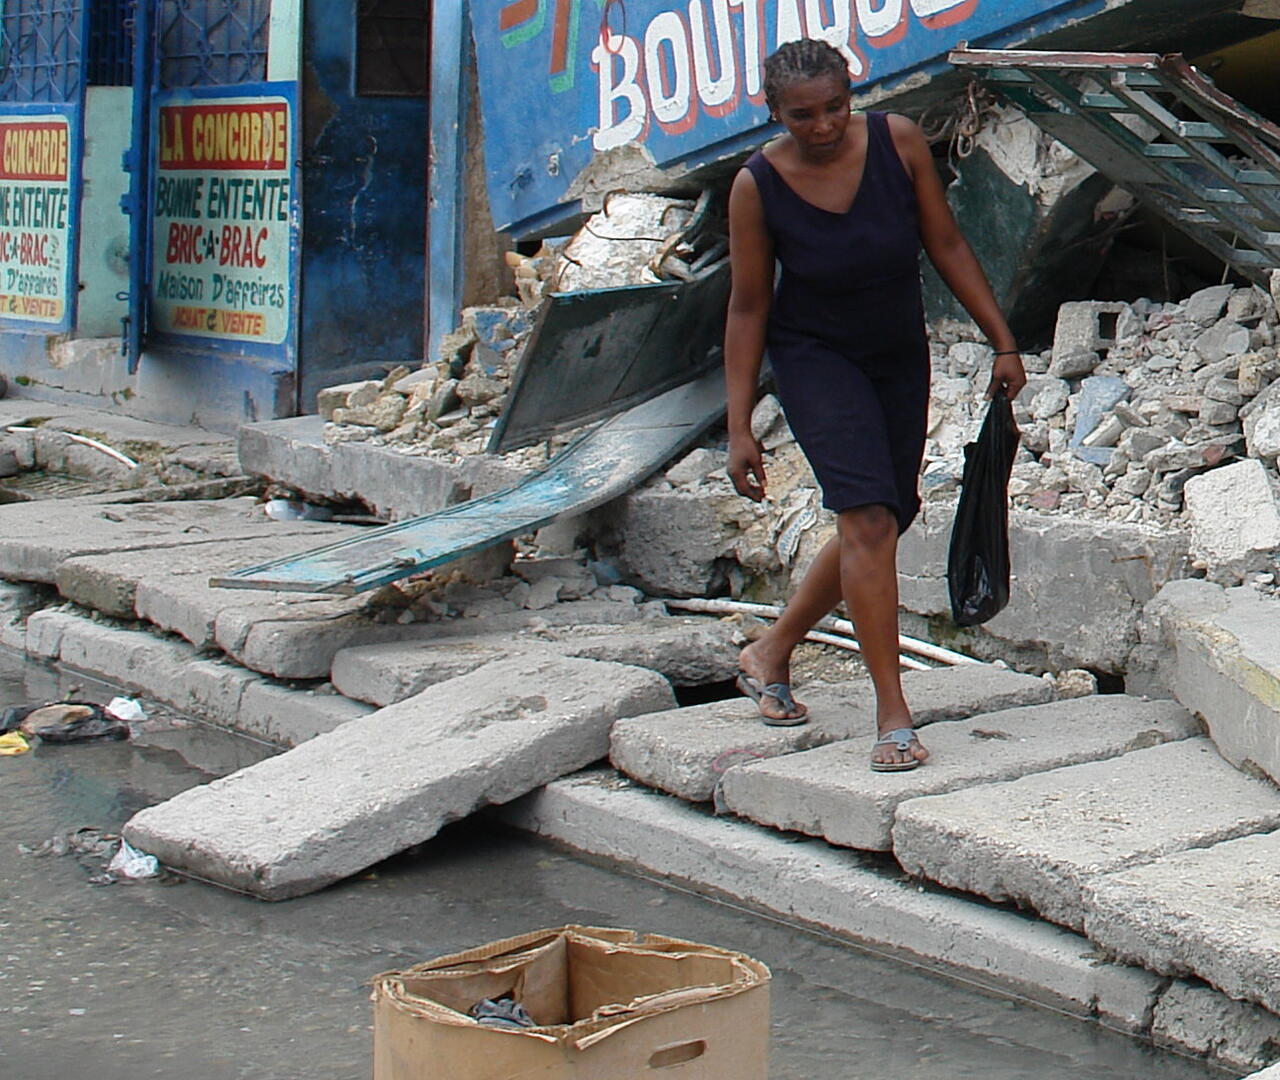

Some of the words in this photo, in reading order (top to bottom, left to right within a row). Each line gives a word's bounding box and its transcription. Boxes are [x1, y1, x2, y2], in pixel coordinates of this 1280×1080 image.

[3, 128, 68, 176] CONCORDE
[161, 112, 184, 162] LA
[192, 110, 286, 162] CONCORDE
[13, 187, 69, 230] ENTENTE
[155, 176, 203, 219] BONNE
[207, 177, 290, 221] ENTENTE
[157, 270, 204, 300] Maison
[21, 296, 57, 318] VENTE
[222, 311, 264, 335] VENTE
